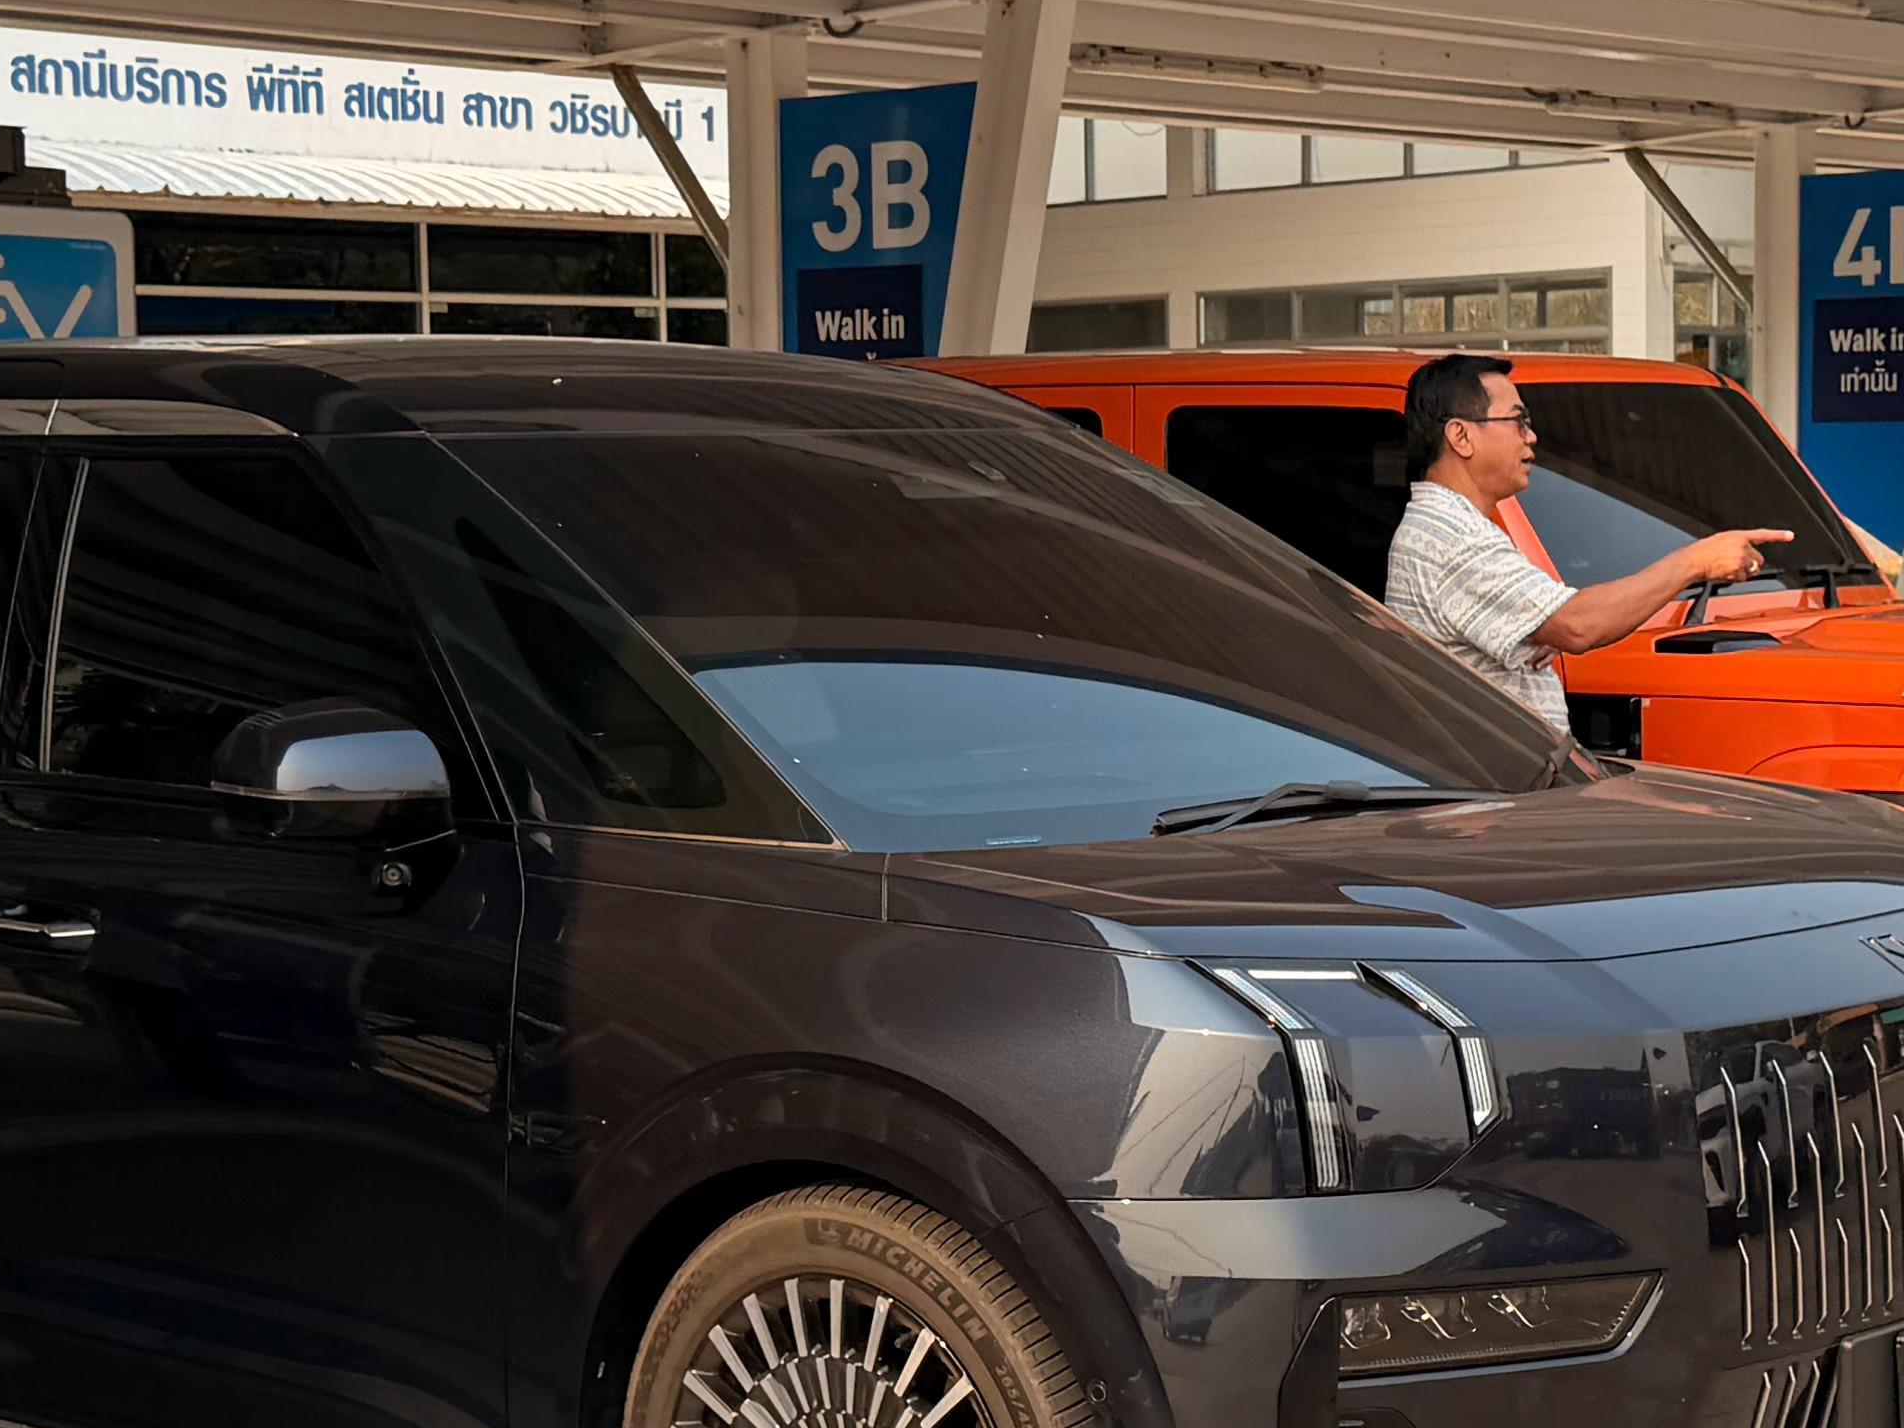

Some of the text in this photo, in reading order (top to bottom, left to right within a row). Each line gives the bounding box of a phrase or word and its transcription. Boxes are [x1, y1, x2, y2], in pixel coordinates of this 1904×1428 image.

[9, 48, 228, 110] สถานีบริการ
[246, 63, 325, 116] พีทีที
[343, 68, 446, 126] สเตชั่น
[462, 91, 533, 132] สาขา
[700, 105, 715, 142] 1
[811, 140, 931, 253] 3B
[814, 307, 906, 343] Walk in
[1828, 326, 1887, 353] Walk
[847, 1228, 990, 1341] MICHELIN
